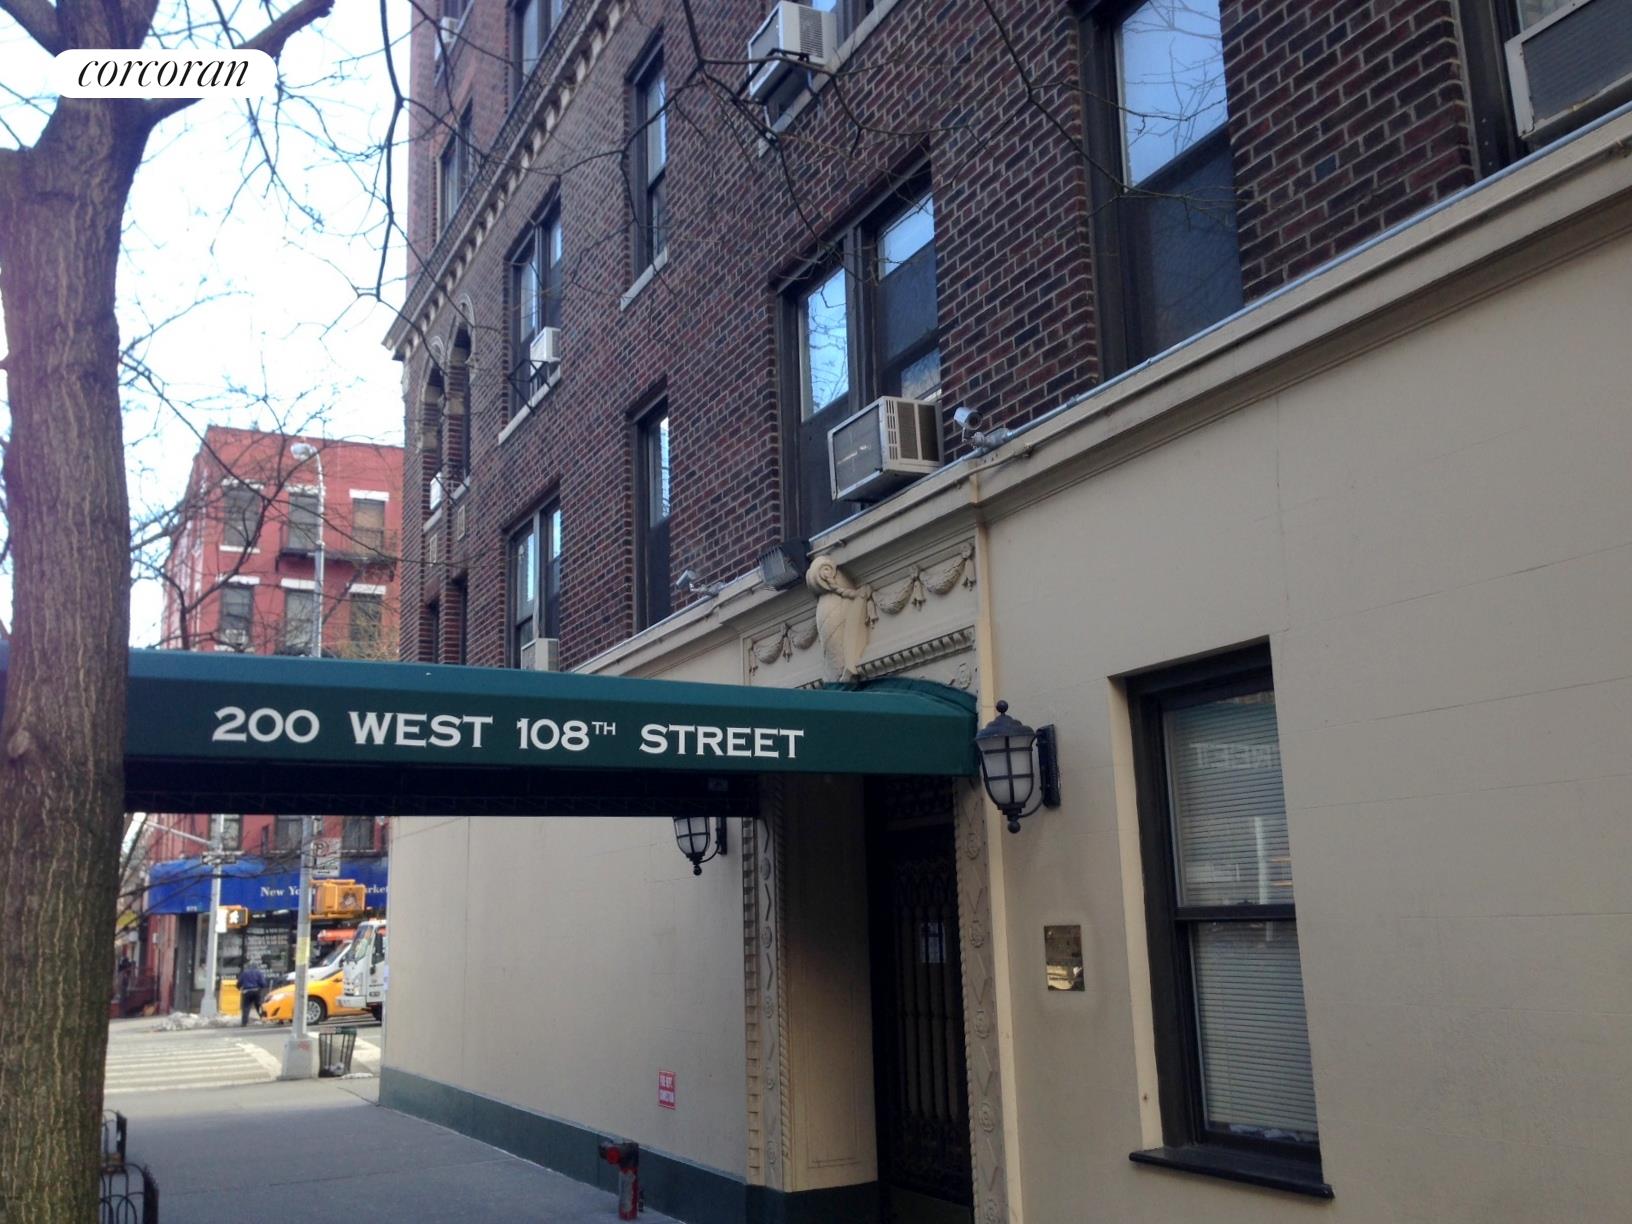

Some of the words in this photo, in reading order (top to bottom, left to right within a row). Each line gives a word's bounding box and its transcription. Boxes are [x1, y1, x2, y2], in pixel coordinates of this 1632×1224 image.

[212, 706, 320, 744] 200
[348, 711, 494, 748] WEST
[516, 717, 616, 752] 108TH
[639, 723, 805, 759] STREET
[260, 886, 286, 897] New
